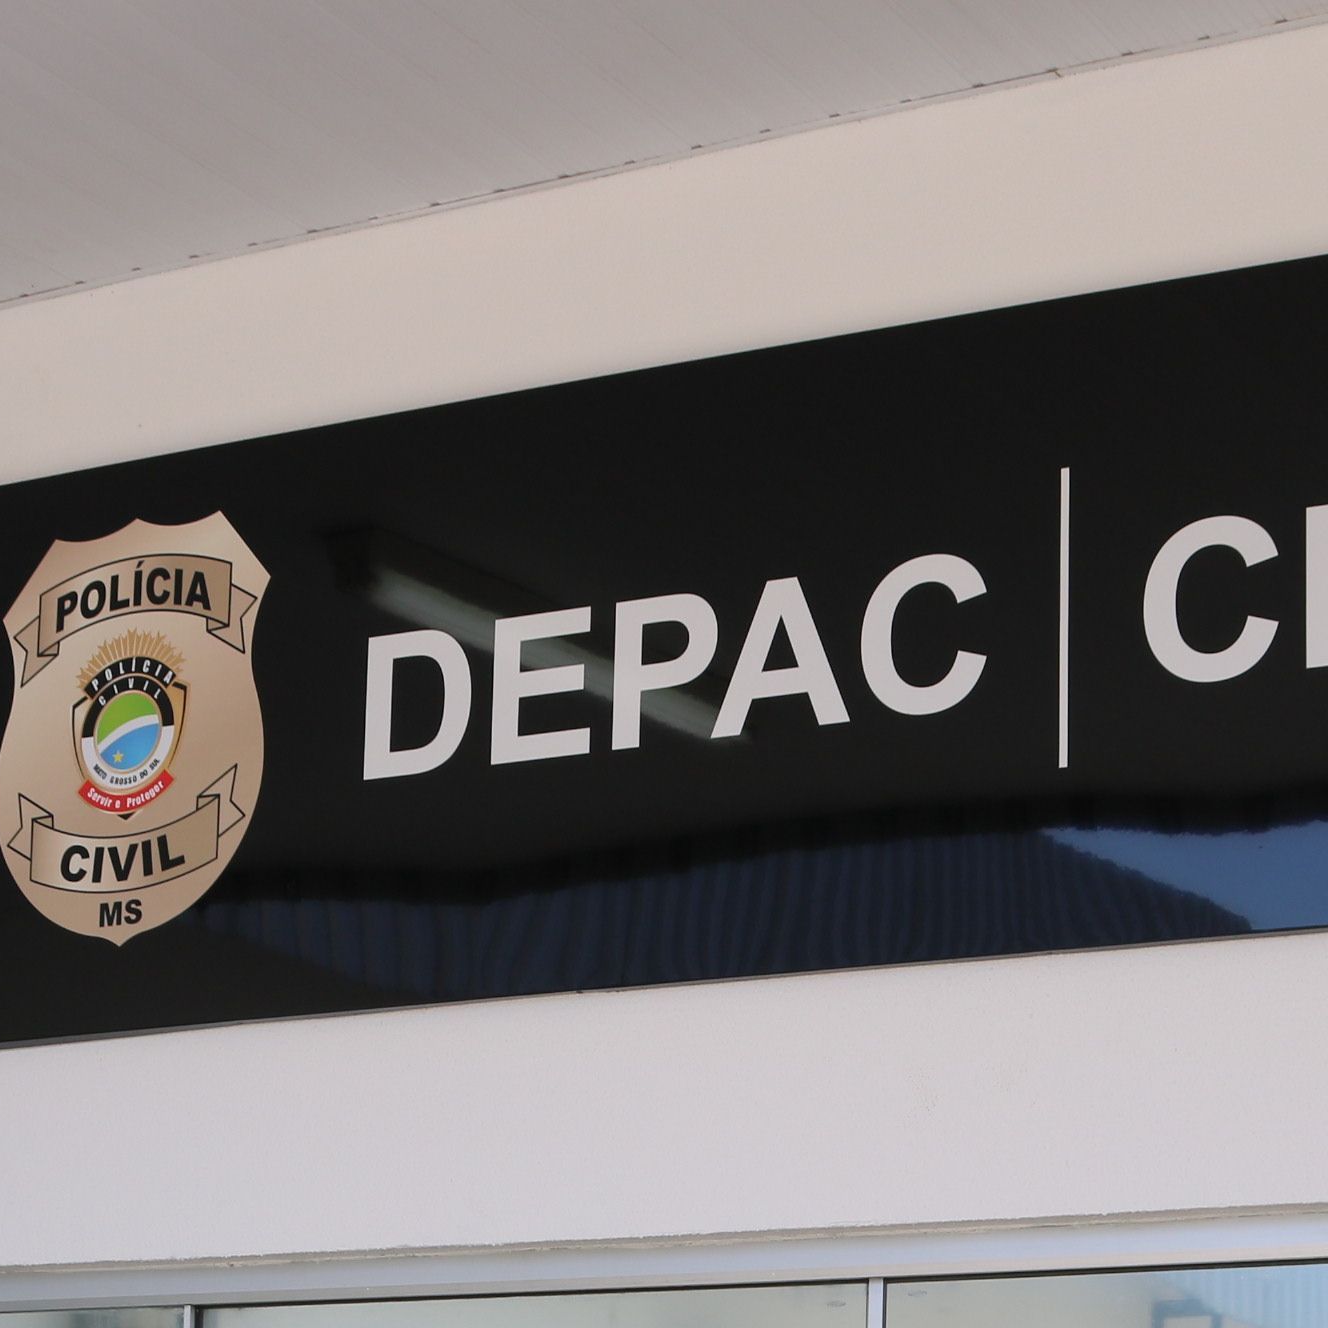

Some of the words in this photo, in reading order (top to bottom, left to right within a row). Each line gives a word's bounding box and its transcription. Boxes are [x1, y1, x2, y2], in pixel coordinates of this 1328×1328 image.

[55, 560, 211, 632] POLÍCIA
[92, 657, 173, 691] POLÍCIA
[363, 553, 987, 780] DEPAC
[98, 678, 161, 706] CIVIL
[110, 776, 137, 785] GROSSO
[139, 769, 148, 779] DO
[87, 788, 113, 807] Servir
[114, 800, 121, 808] e
[127, 781, 164, 808] Proteger
[60, 835, 185, 883] CIVIL
[99, 899, 142, 928] MS
